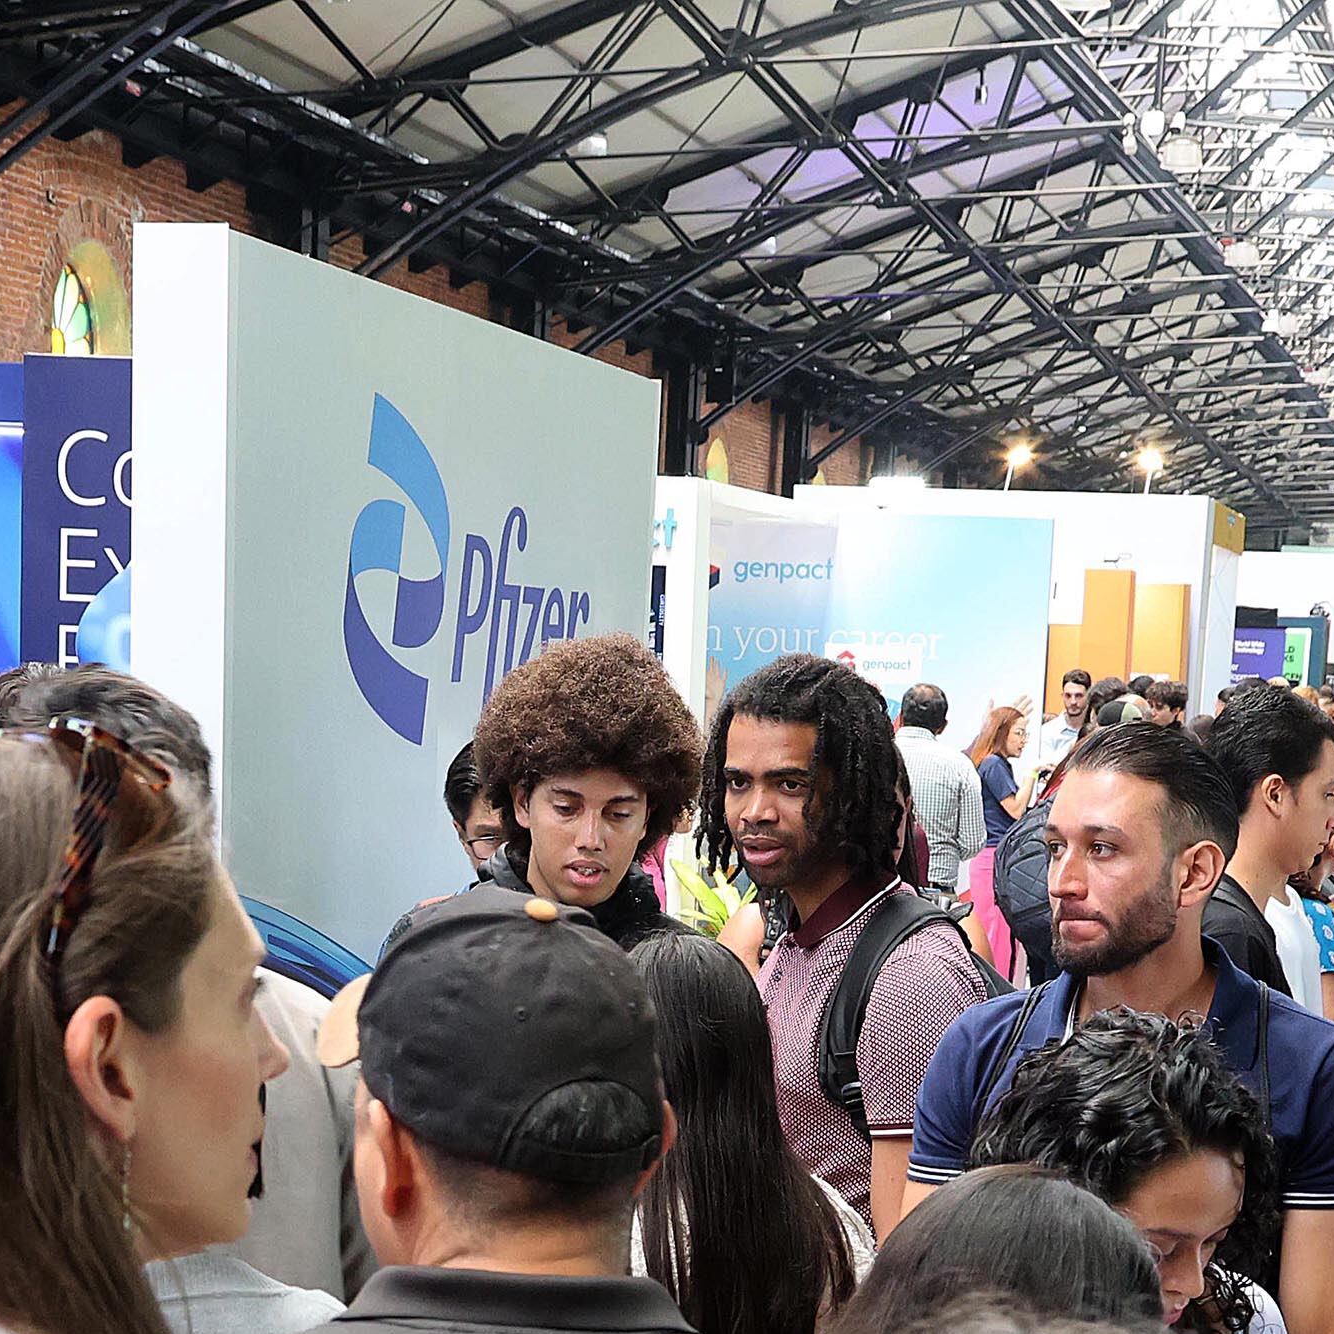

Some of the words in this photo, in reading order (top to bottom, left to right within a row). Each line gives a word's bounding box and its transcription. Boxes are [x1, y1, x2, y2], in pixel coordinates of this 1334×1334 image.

[733, 558, 833, 584] genpact
[733, 626, 819, 661] your
[863, 660, 911, 672] genpact
